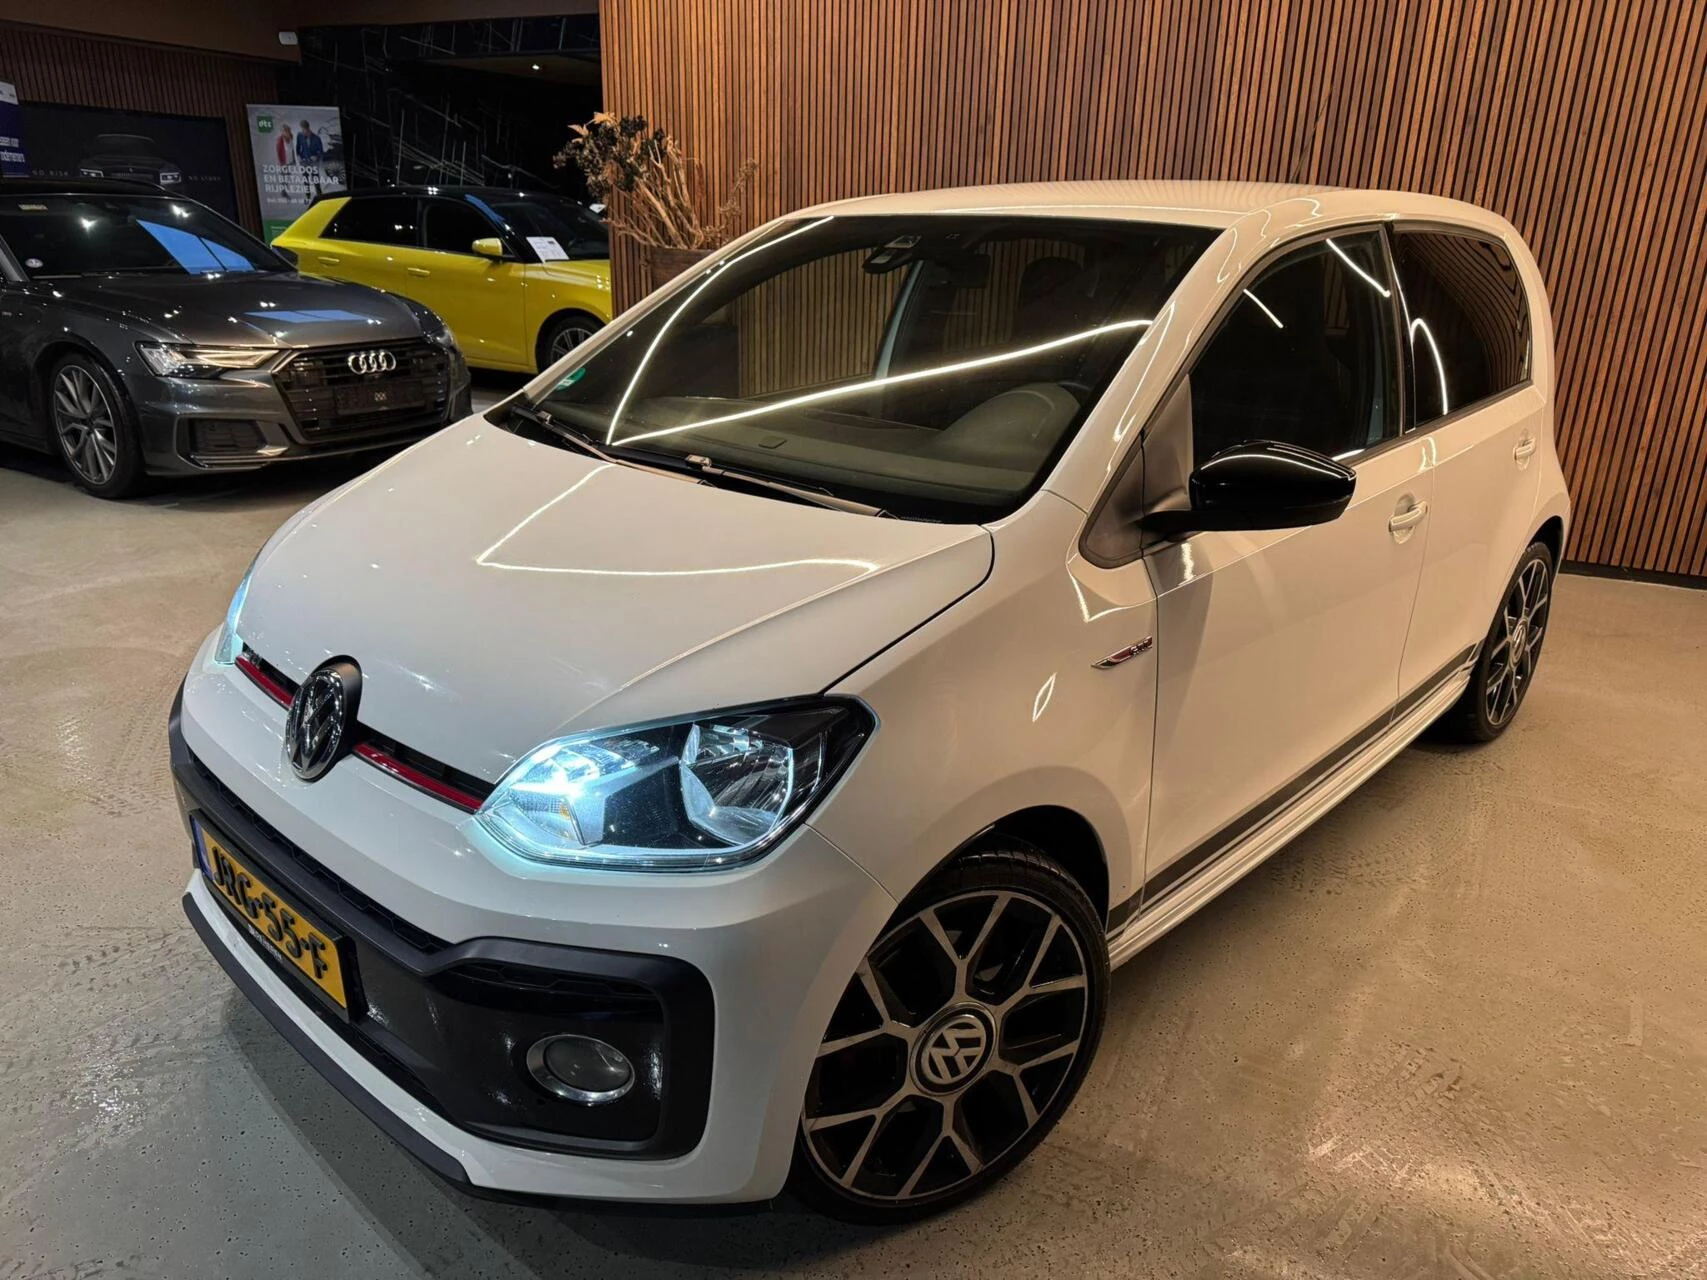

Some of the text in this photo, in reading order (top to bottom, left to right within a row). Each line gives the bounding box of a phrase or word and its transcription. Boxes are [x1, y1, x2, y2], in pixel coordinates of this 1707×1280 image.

[263, 164, 319, 175] ZORGELOOS
[264, 174, 339, 186] EN BETAALBAAR
[265, 183, 317, 194] RIJPLEZIER
[213, 846, 328, 980] JRG-55-F
